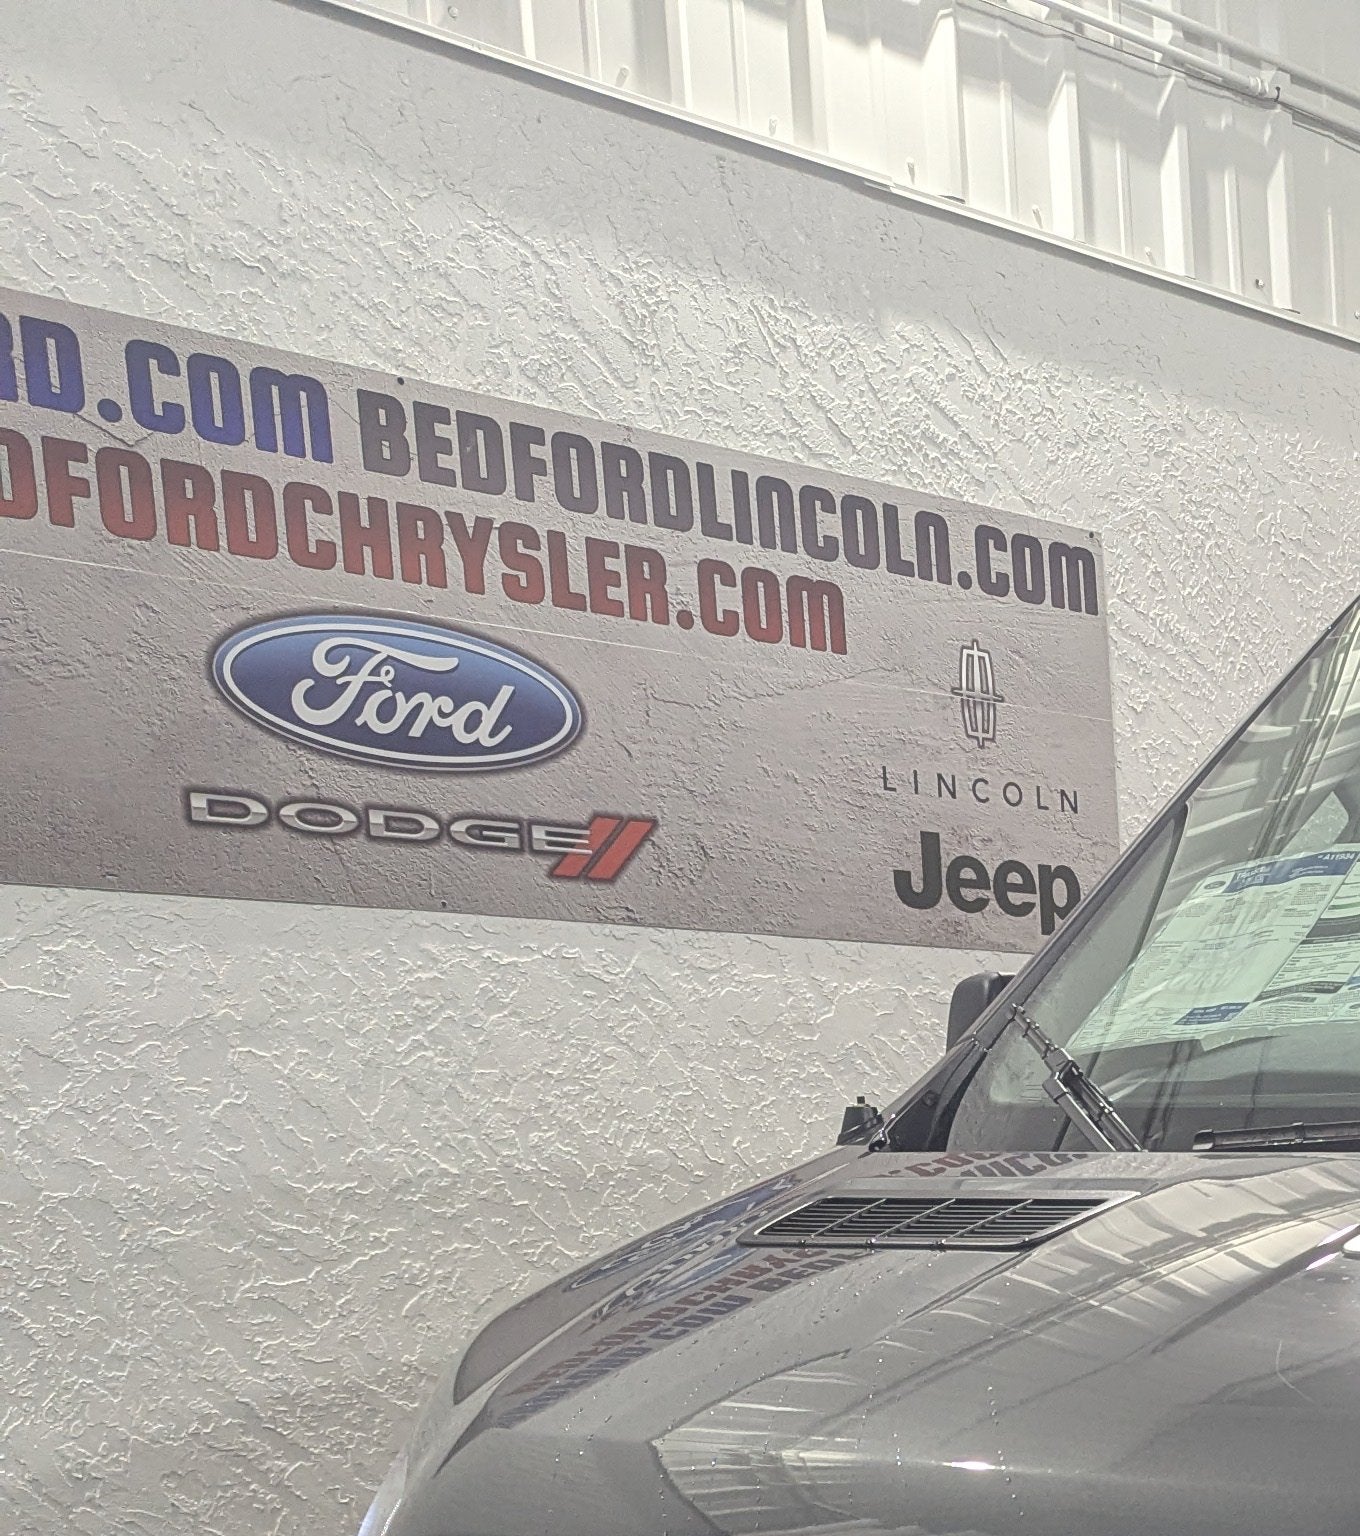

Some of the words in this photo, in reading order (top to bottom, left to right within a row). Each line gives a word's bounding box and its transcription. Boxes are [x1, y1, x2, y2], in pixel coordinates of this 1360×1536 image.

[356, 388, 1099, 616] BEDFORDLINCOLN.COM
[291, 636, 515, 748] Ford
[190, 791, 593, 856] DODGE
[881, 765, 1079, 814] LINCOLN
[892, 830, 1082, 936] Jeep
